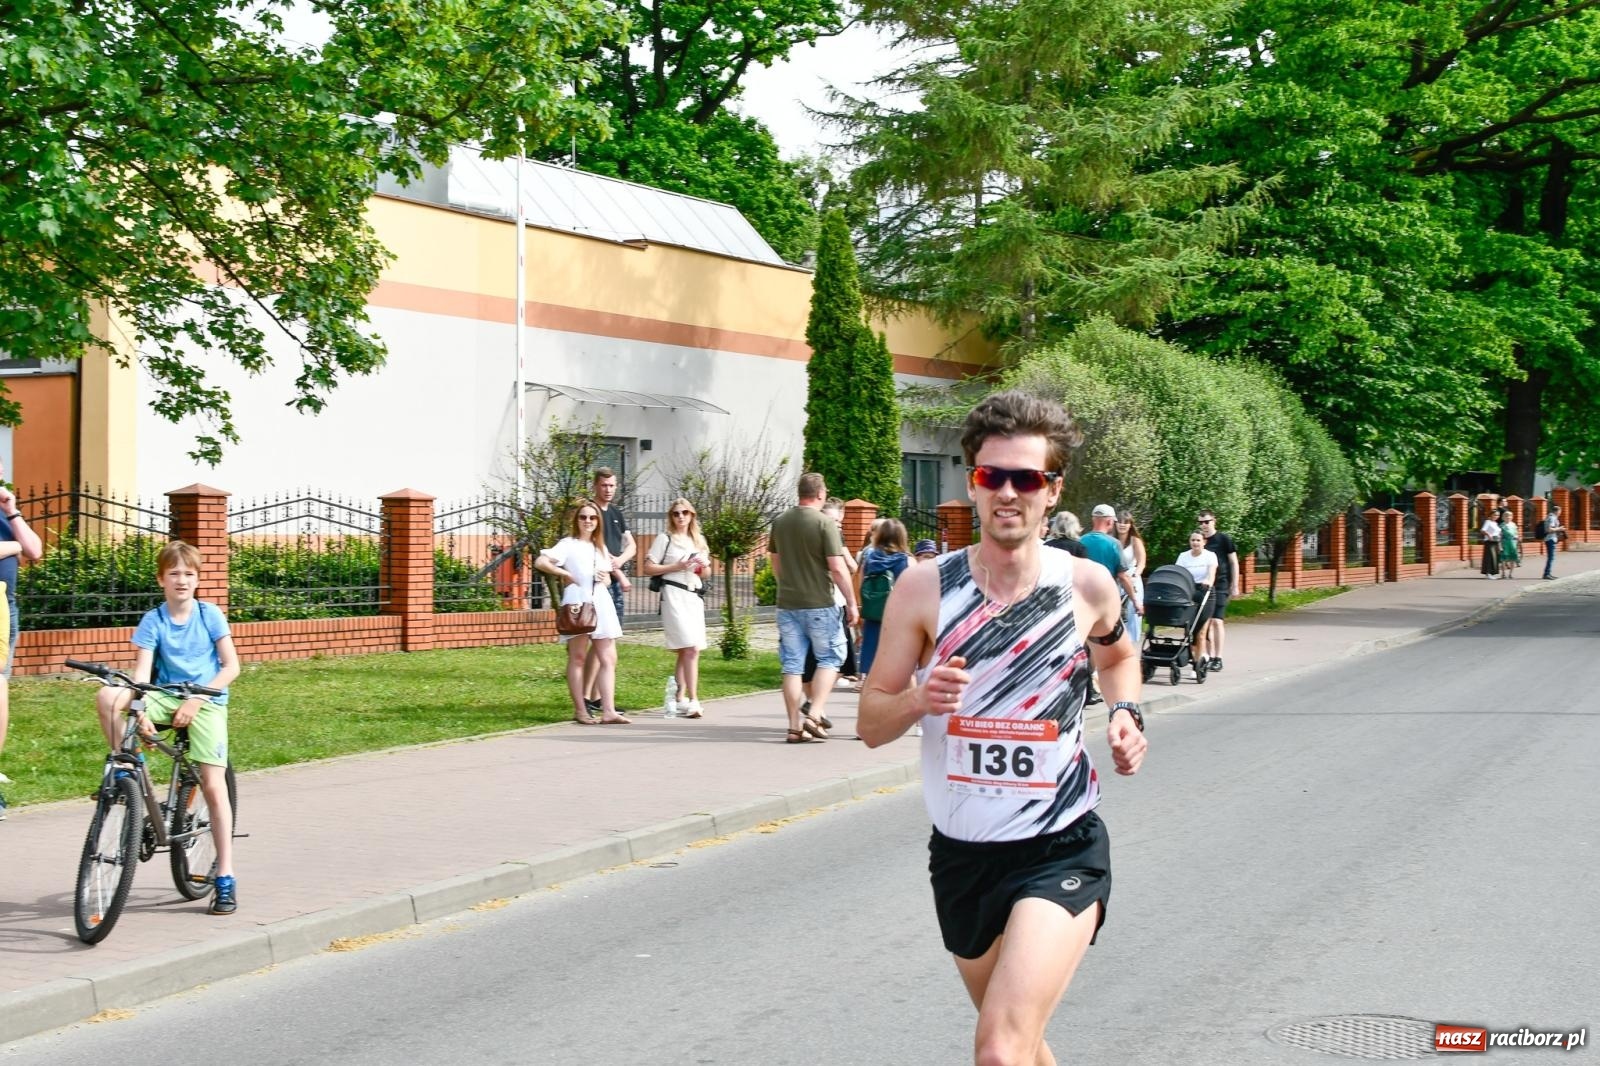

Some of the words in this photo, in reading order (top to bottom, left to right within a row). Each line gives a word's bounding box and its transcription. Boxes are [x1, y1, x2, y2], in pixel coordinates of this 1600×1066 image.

[995, 721, 1011, 730] BEZ
[1012, 722, 1045, 731] GRANIC
[969, 743, 1034, 778] 136
